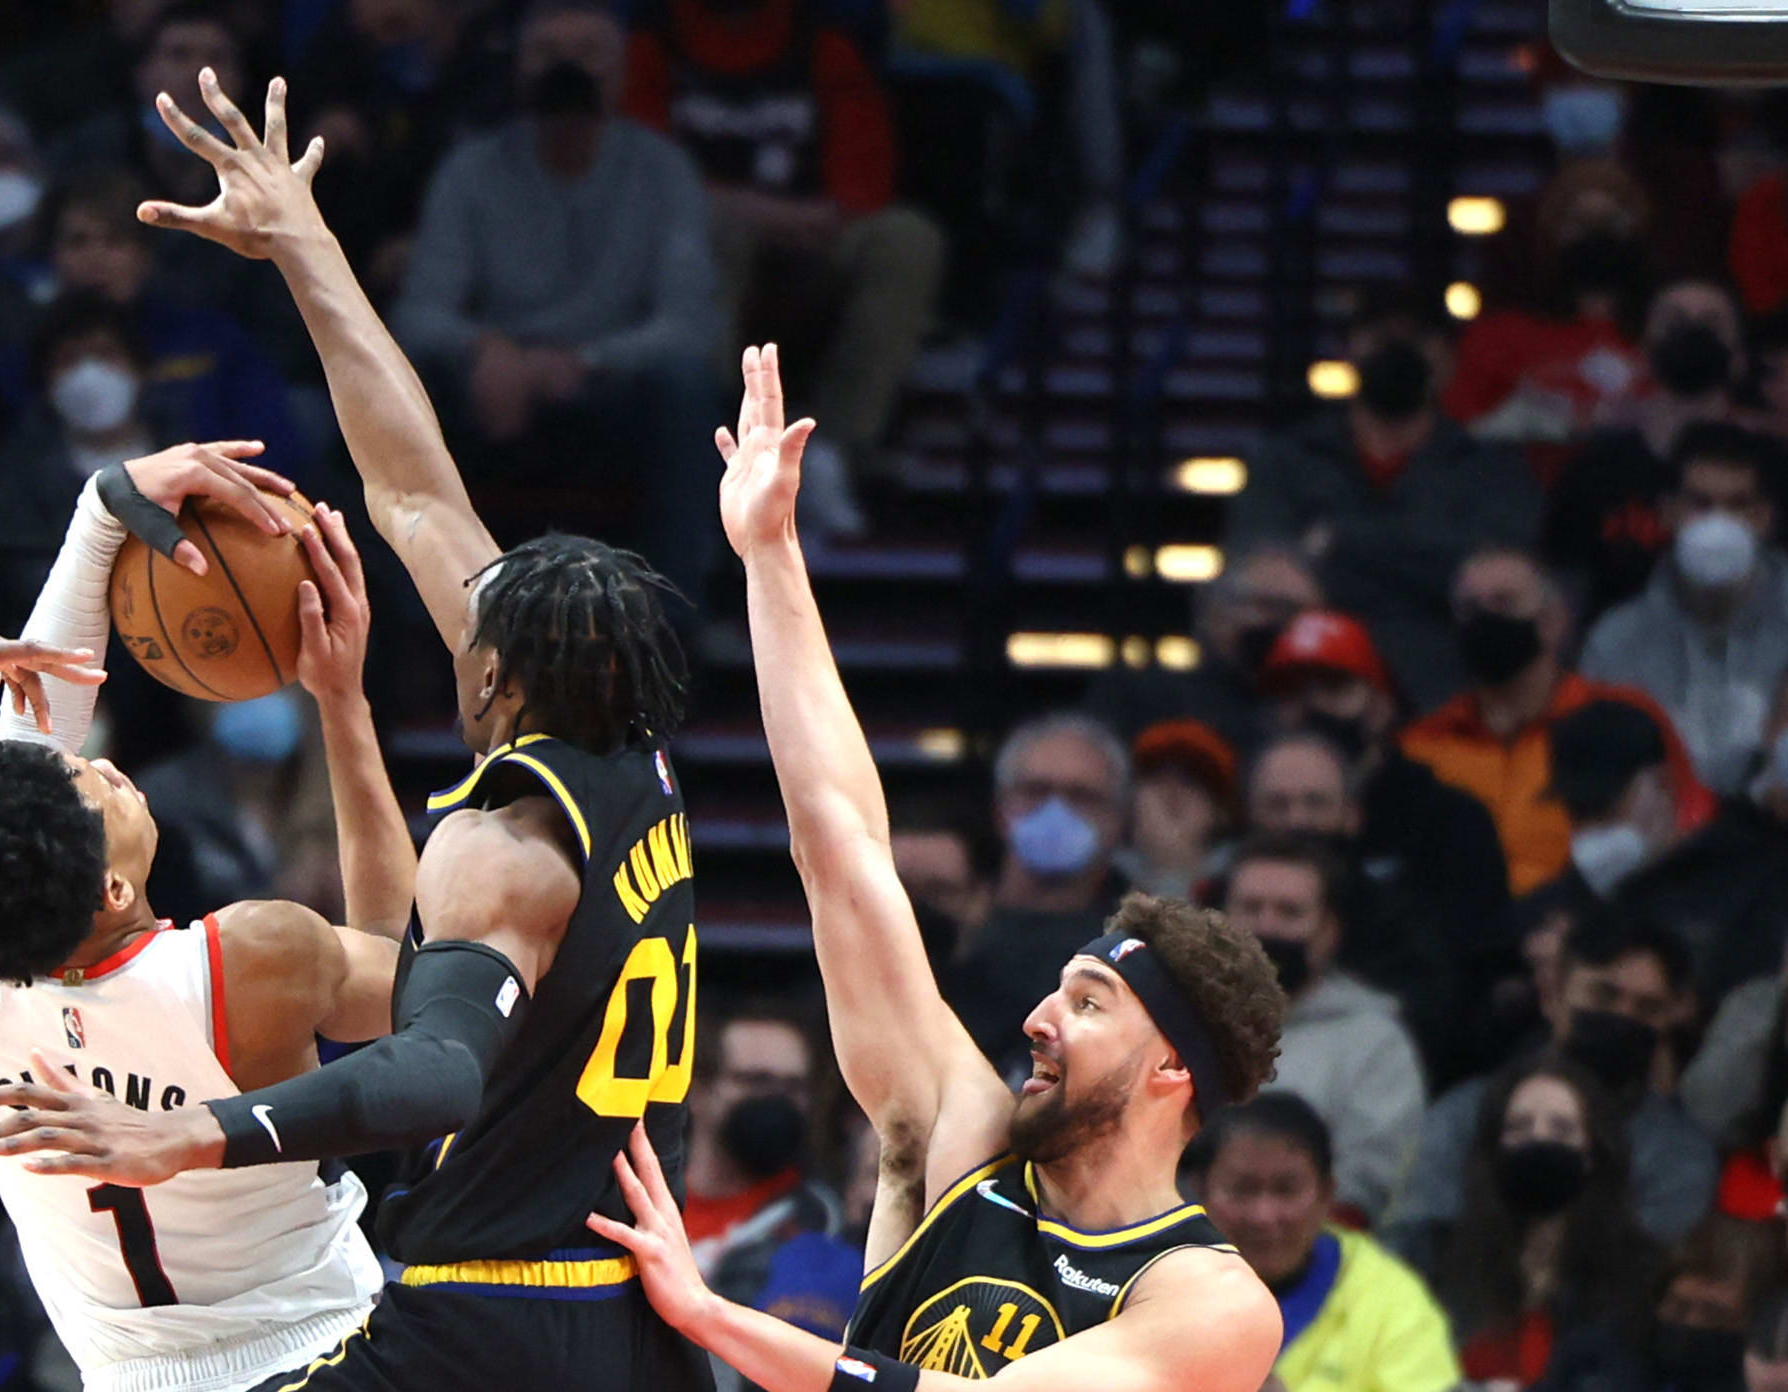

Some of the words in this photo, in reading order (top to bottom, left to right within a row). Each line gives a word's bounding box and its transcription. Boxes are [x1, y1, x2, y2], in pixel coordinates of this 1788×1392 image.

[86, 1181, 180, 1308] 1
[1053, 1253, 1120, 1297] Rakuten
[980, 1302, 1042, 1361] 11
